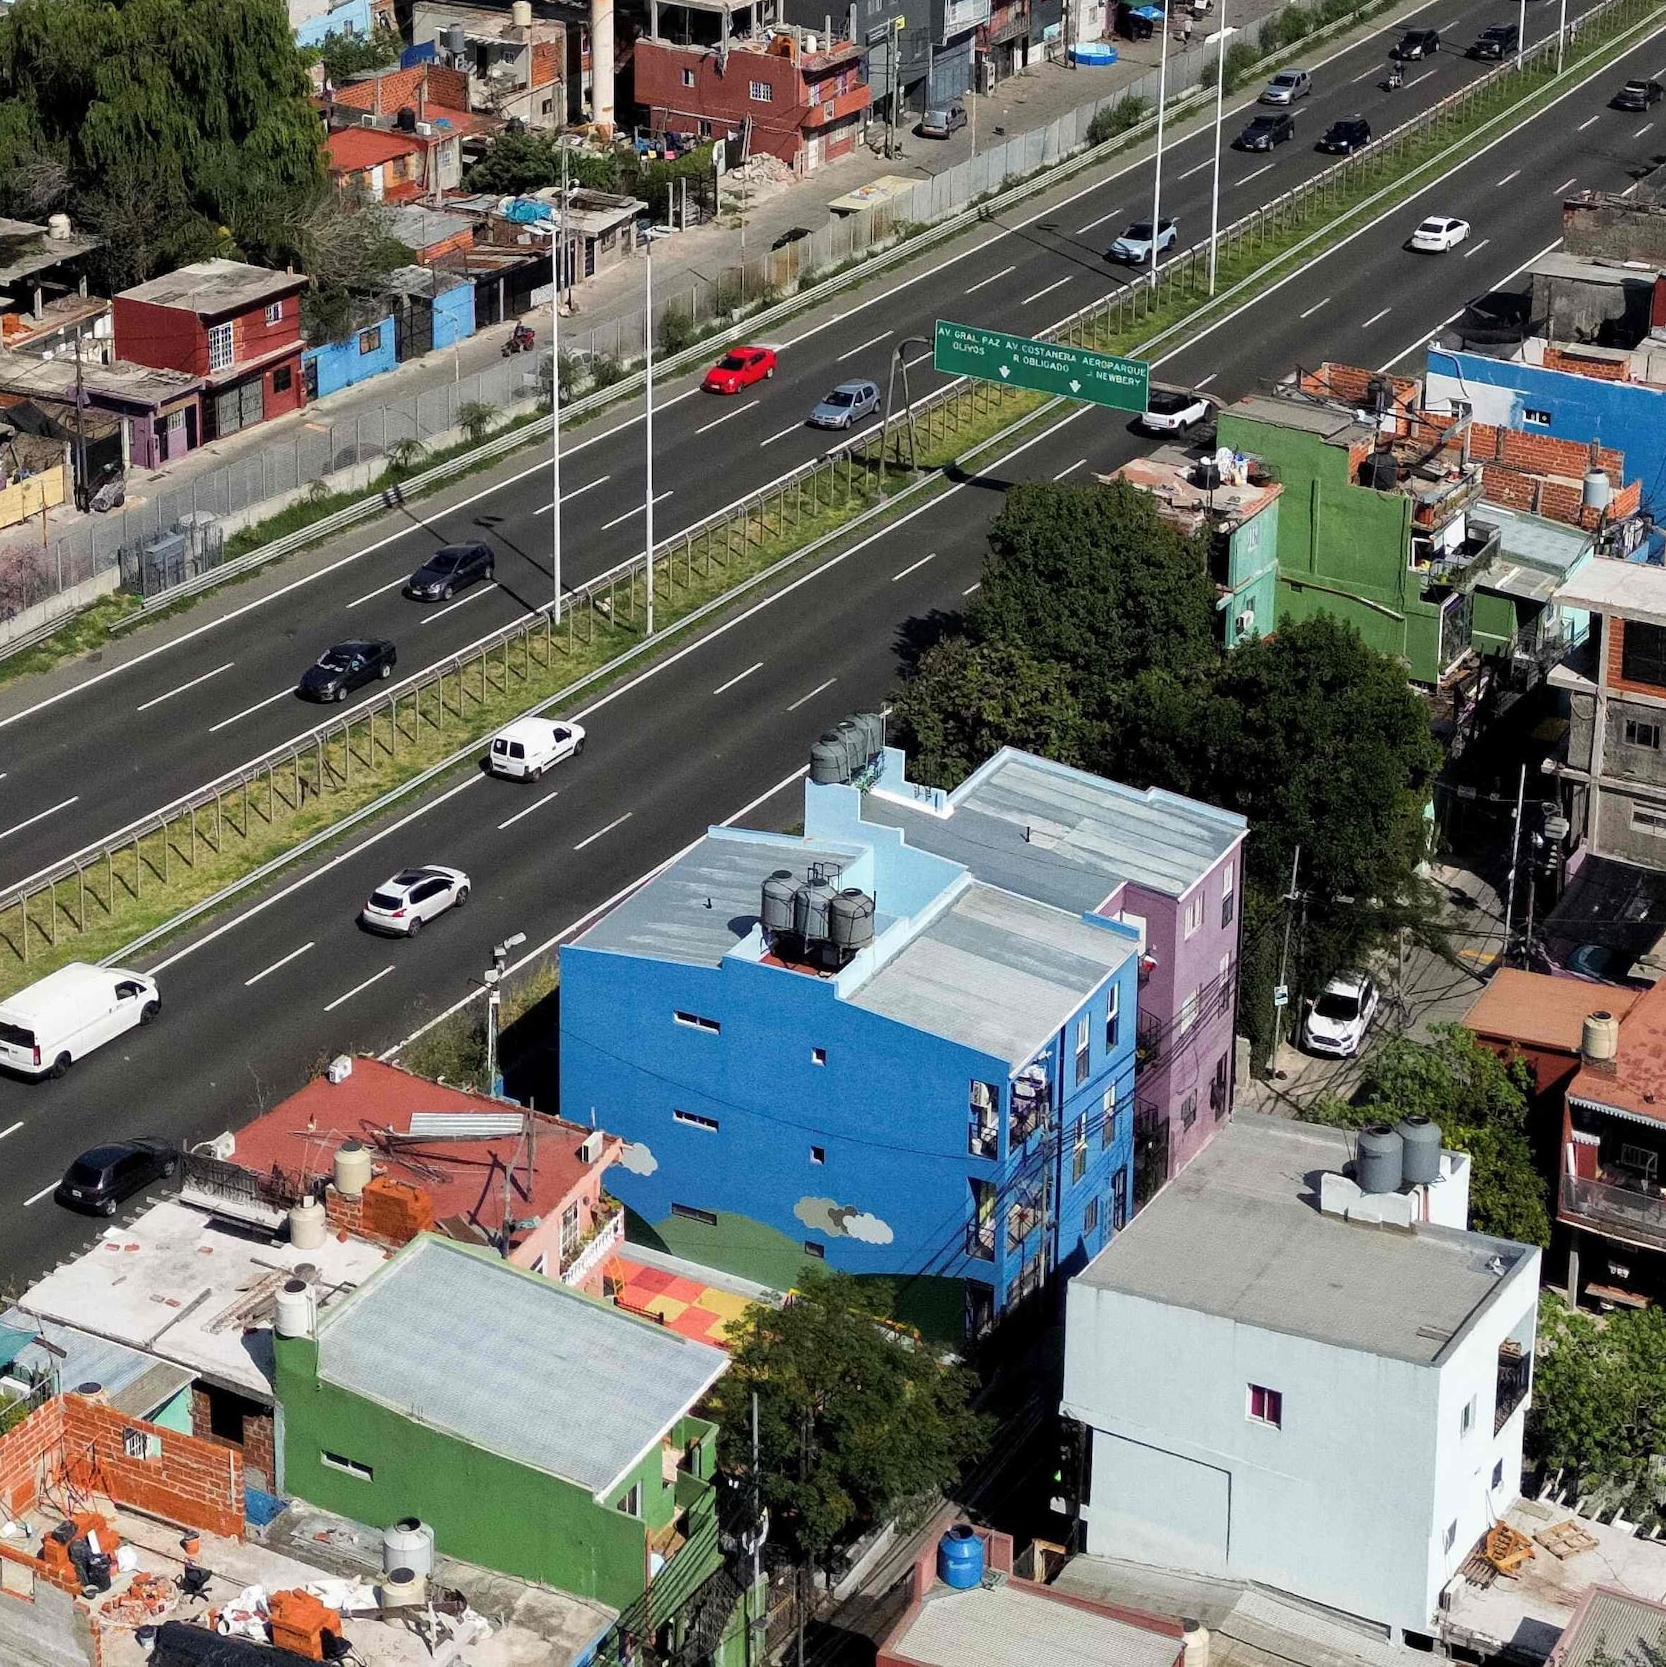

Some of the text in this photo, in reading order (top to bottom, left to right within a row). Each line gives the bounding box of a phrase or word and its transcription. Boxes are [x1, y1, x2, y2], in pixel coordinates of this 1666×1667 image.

[981, 336, 1001, 348] PAZ
[1013, 353, 1070, 373] R OBLIGADO
[1021, 344, 1077, 363] COSTANERA
[1081, 356, 1147, 378] AEROPARQUE
[1095, 370, 1141, 387] NEWBERY
